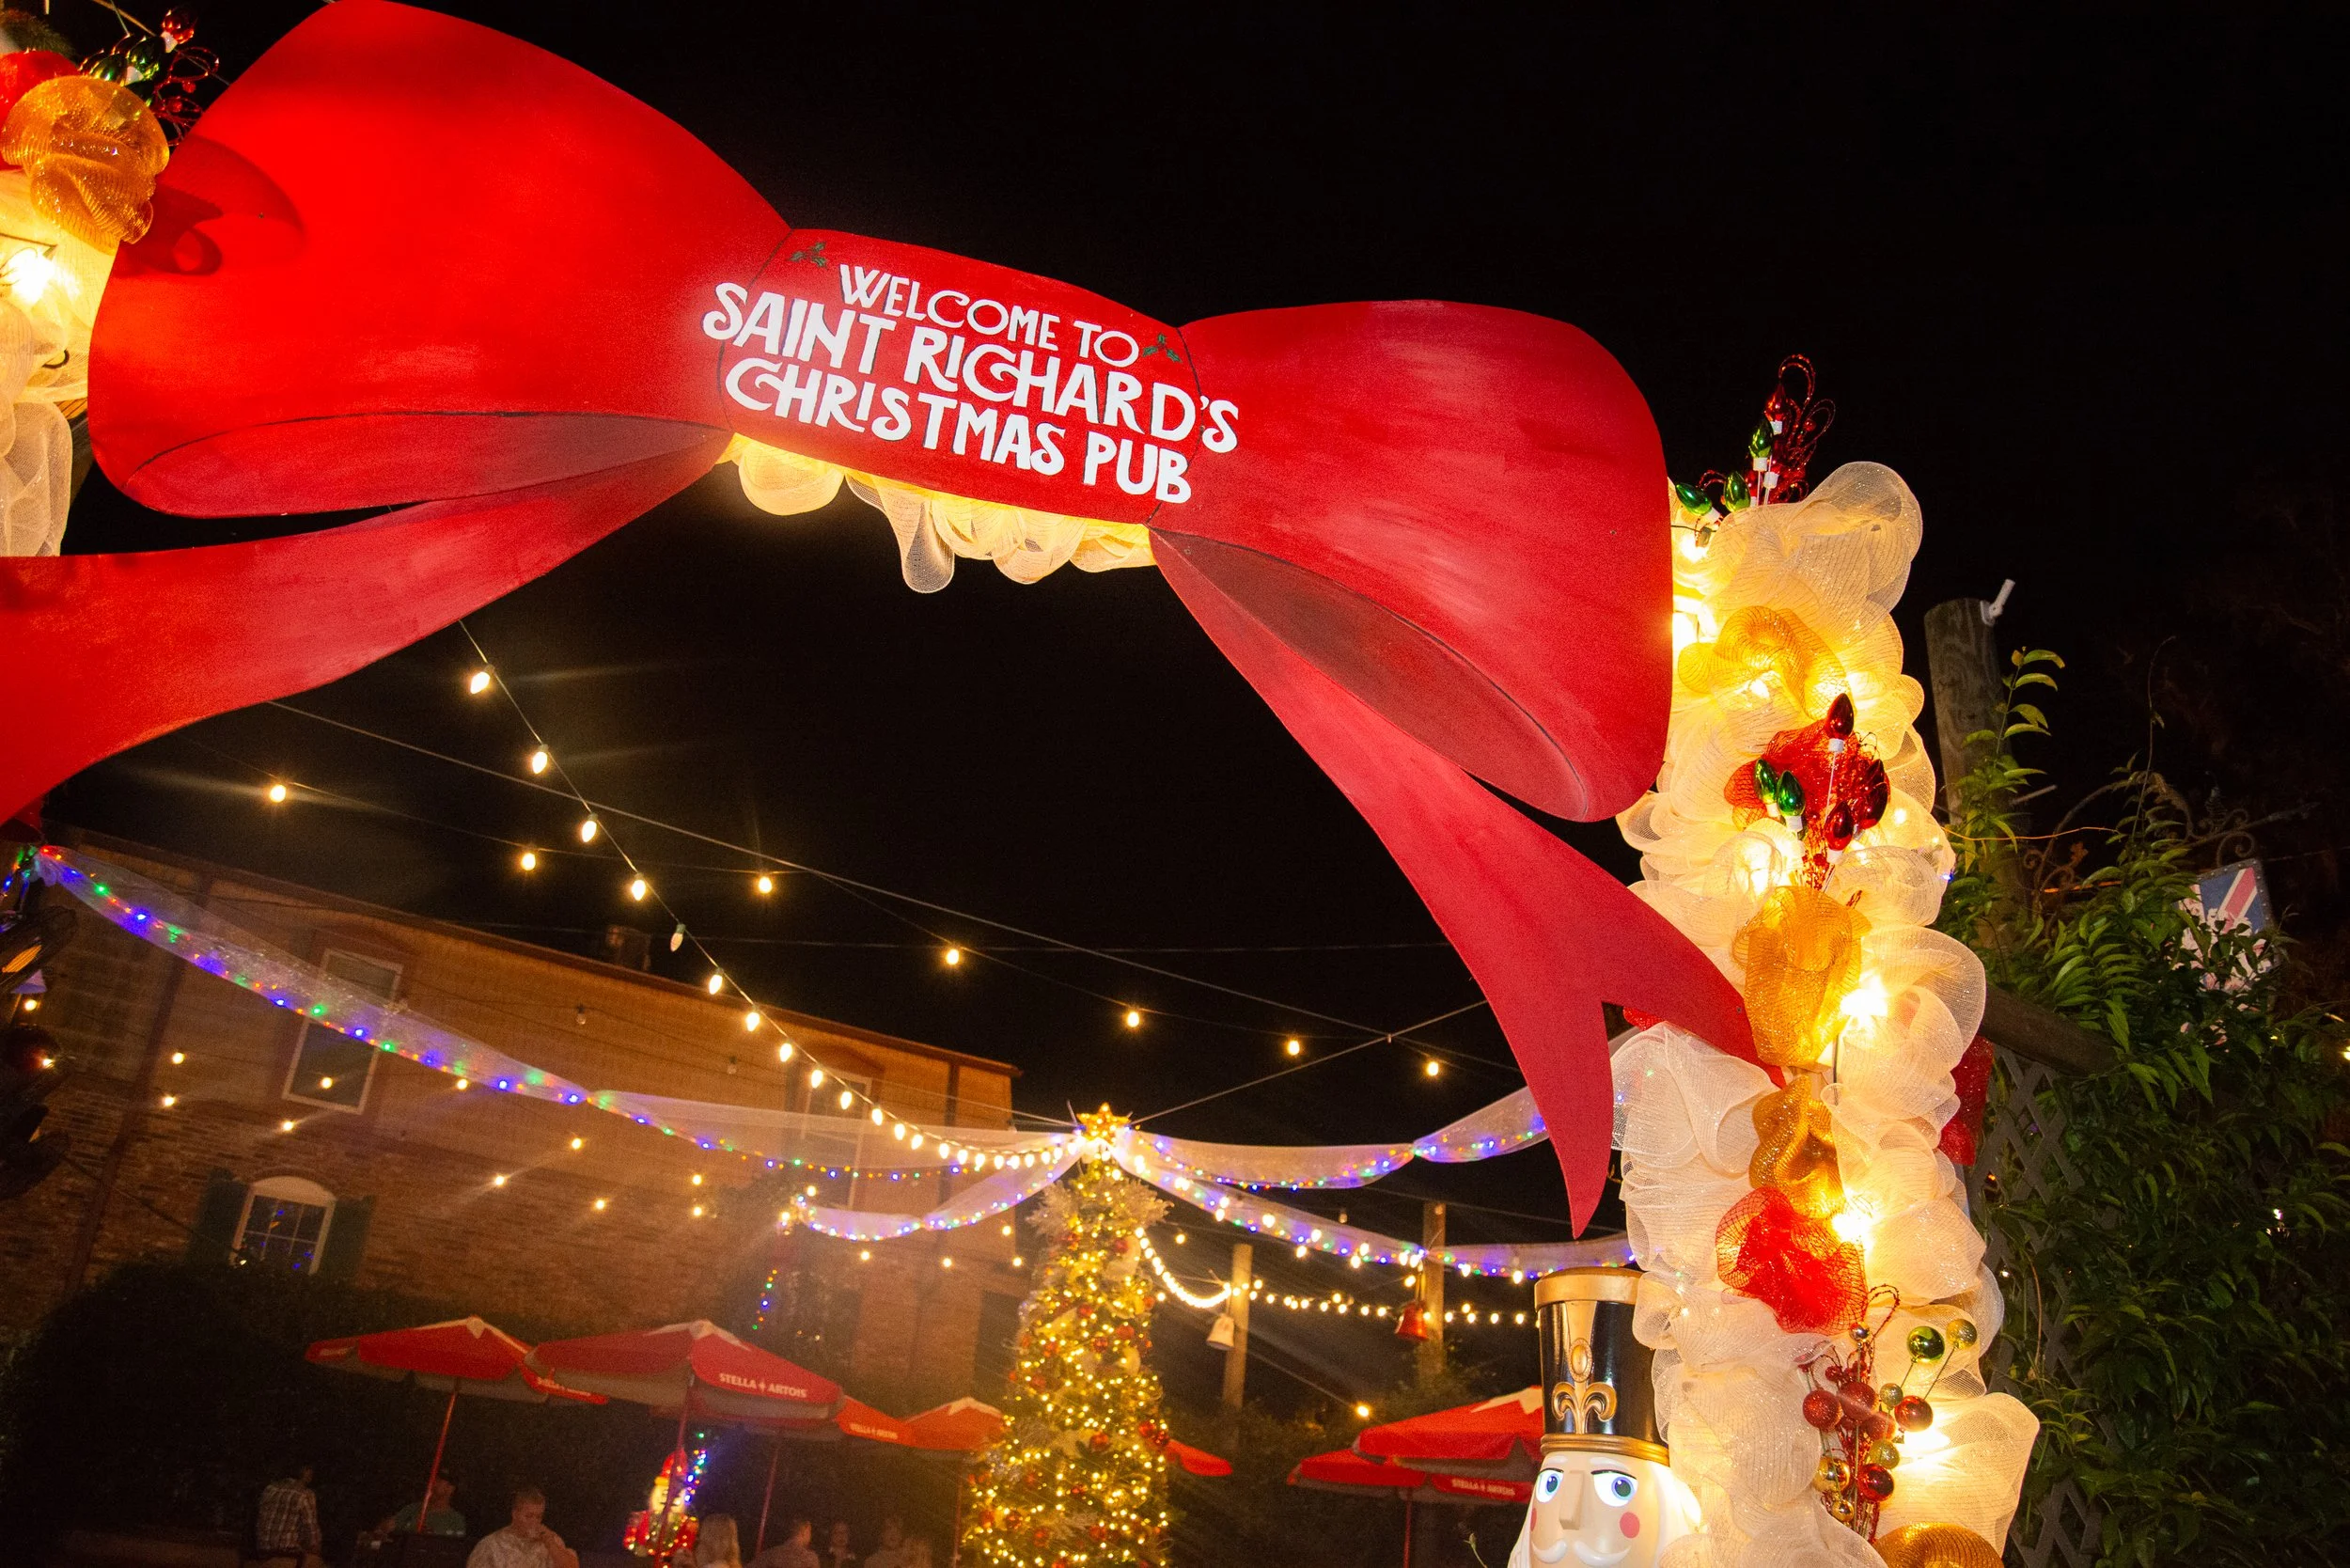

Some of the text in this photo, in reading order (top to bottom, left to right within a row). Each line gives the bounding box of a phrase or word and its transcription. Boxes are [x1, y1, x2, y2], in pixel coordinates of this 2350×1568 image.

[702, 282, 1239, 453] SAINT RICHARD'S
[839, 264, 1140, 367] WELCOME TO
[725, 357, 1192, 503] CHRISTMAS PUB
[719, 1372, 807, 1398] STELLA ARTOIS
